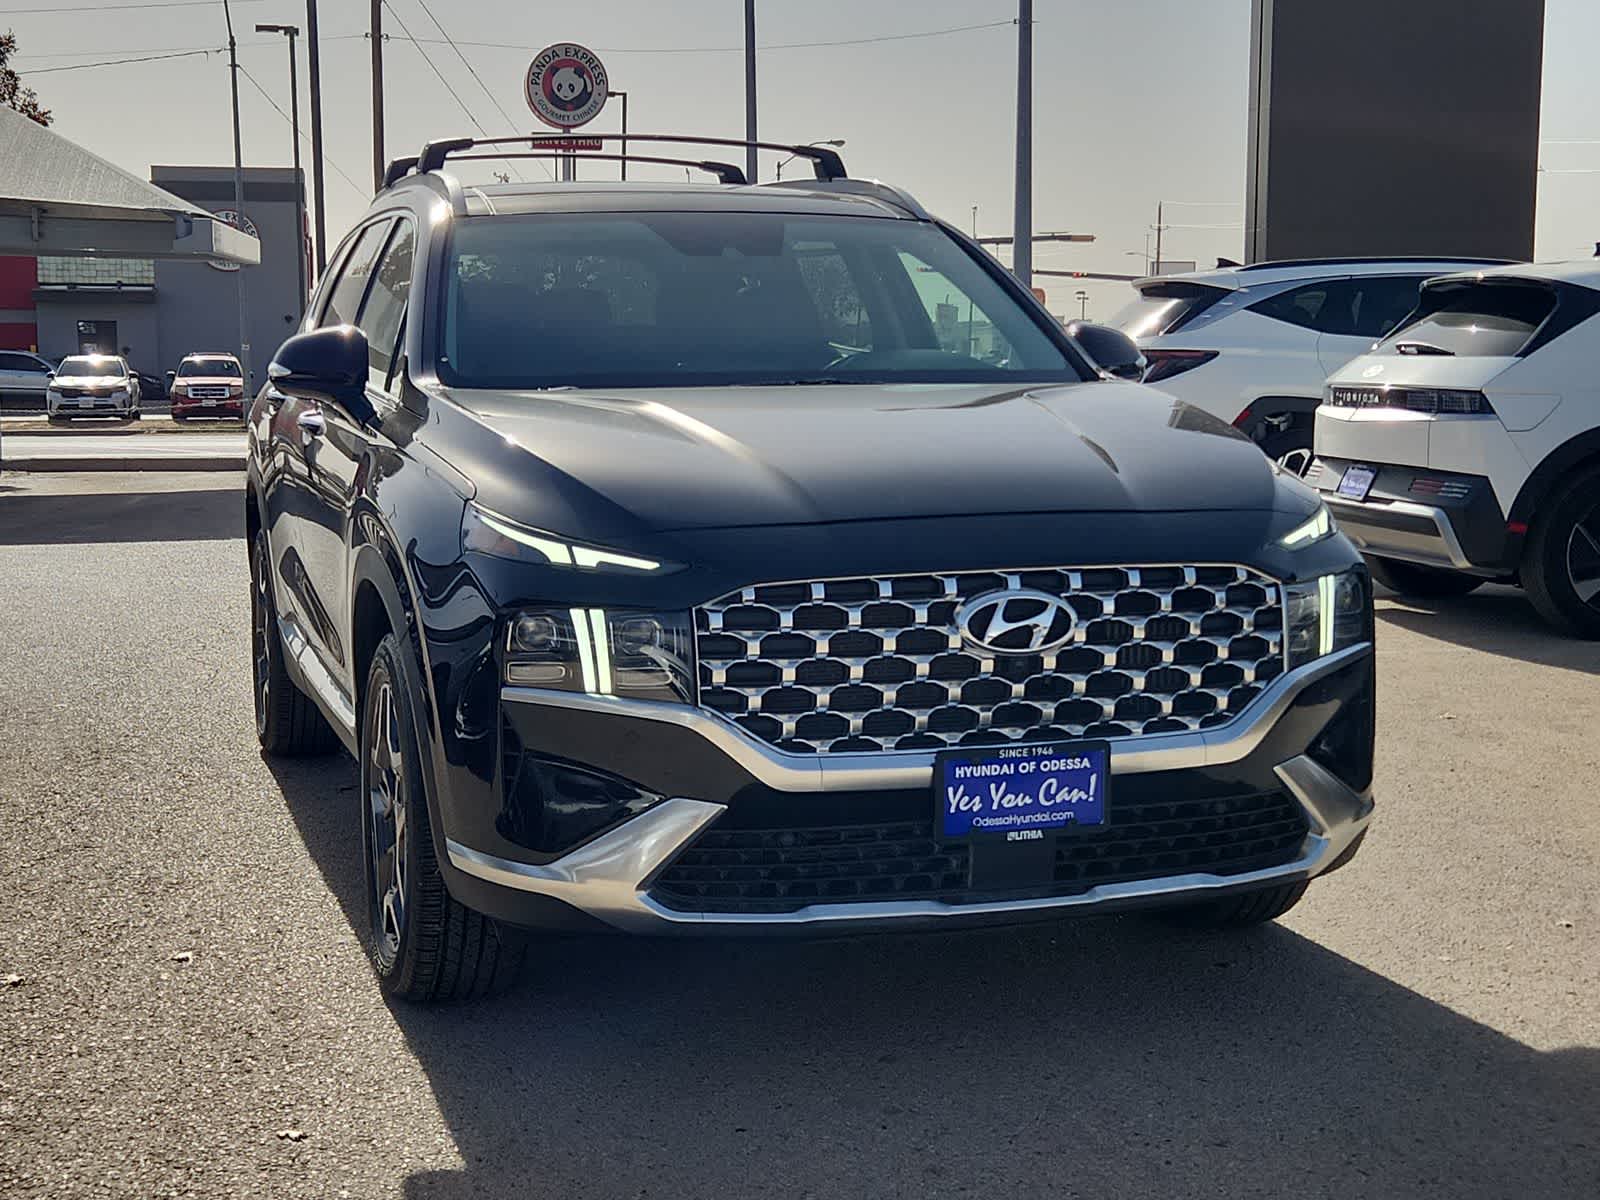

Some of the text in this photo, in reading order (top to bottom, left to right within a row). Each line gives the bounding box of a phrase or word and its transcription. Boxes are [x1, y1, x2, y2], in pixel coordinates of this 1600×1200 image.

[531, 47, 605, 86] PANDA EXPRESS
[999, 746, 1054, 759] SINCE 1946
[955, 758, 1091, 779] HYUNDAI OF ODESSA
[947, 773, 1097, 814] Yes You Can!
[972, 811, 1074, 828] OdessaHyundai.com
